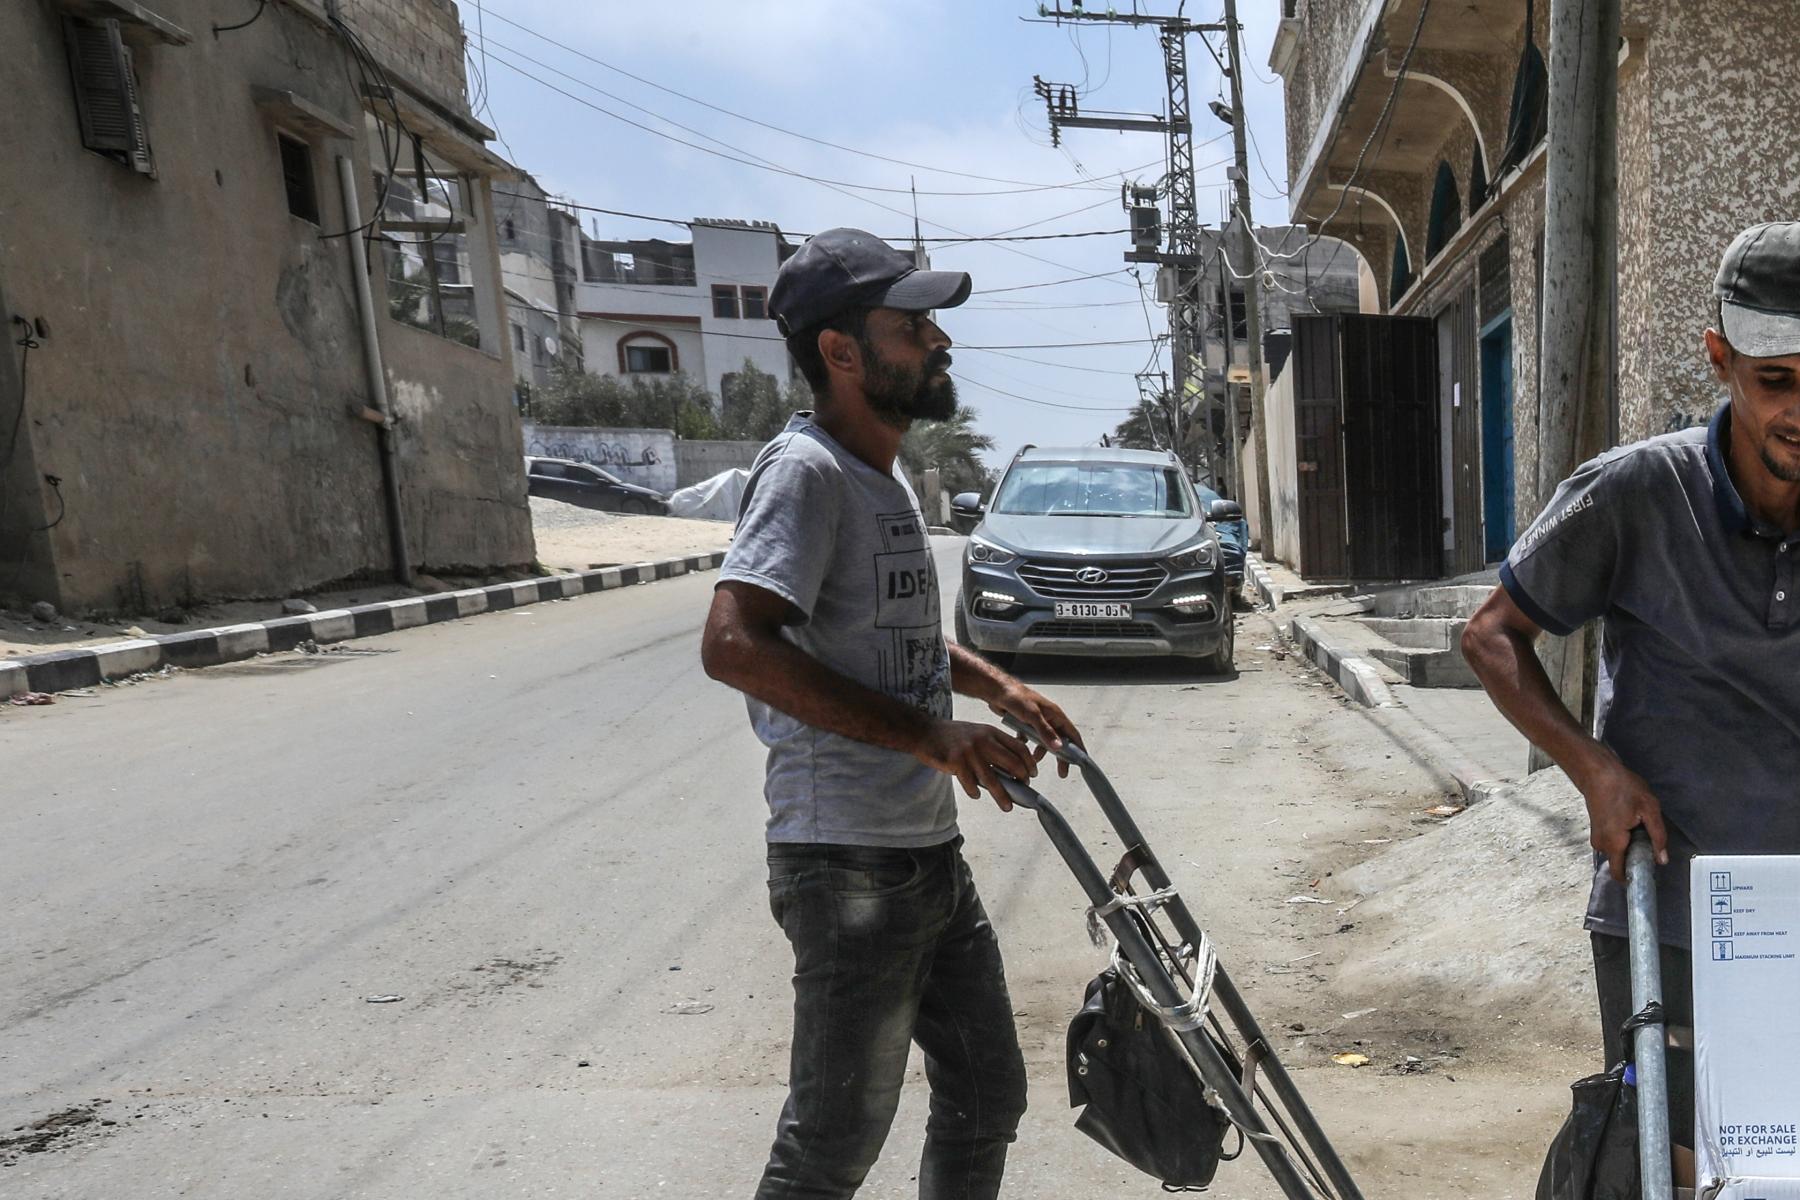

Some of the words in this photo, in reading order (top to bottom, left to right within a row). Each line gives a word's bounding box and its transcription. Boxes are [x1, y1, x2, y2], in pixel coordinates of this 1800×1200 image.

[1560, 493, 1594, 522] FIRST
[1521, 515, 1558, 551] WINNER
[1719, 1125, 1742, 1134] NOT
[1745, 1125, 1767, 1134] FOR
[1770, 1124, 1796, 1133] SALE
[1720, 1136, 1735, 1145] OR
[1738, 1135, 1797, 1145] EXCHANGE
[1776, 1147, 1796, 1156] ليست
